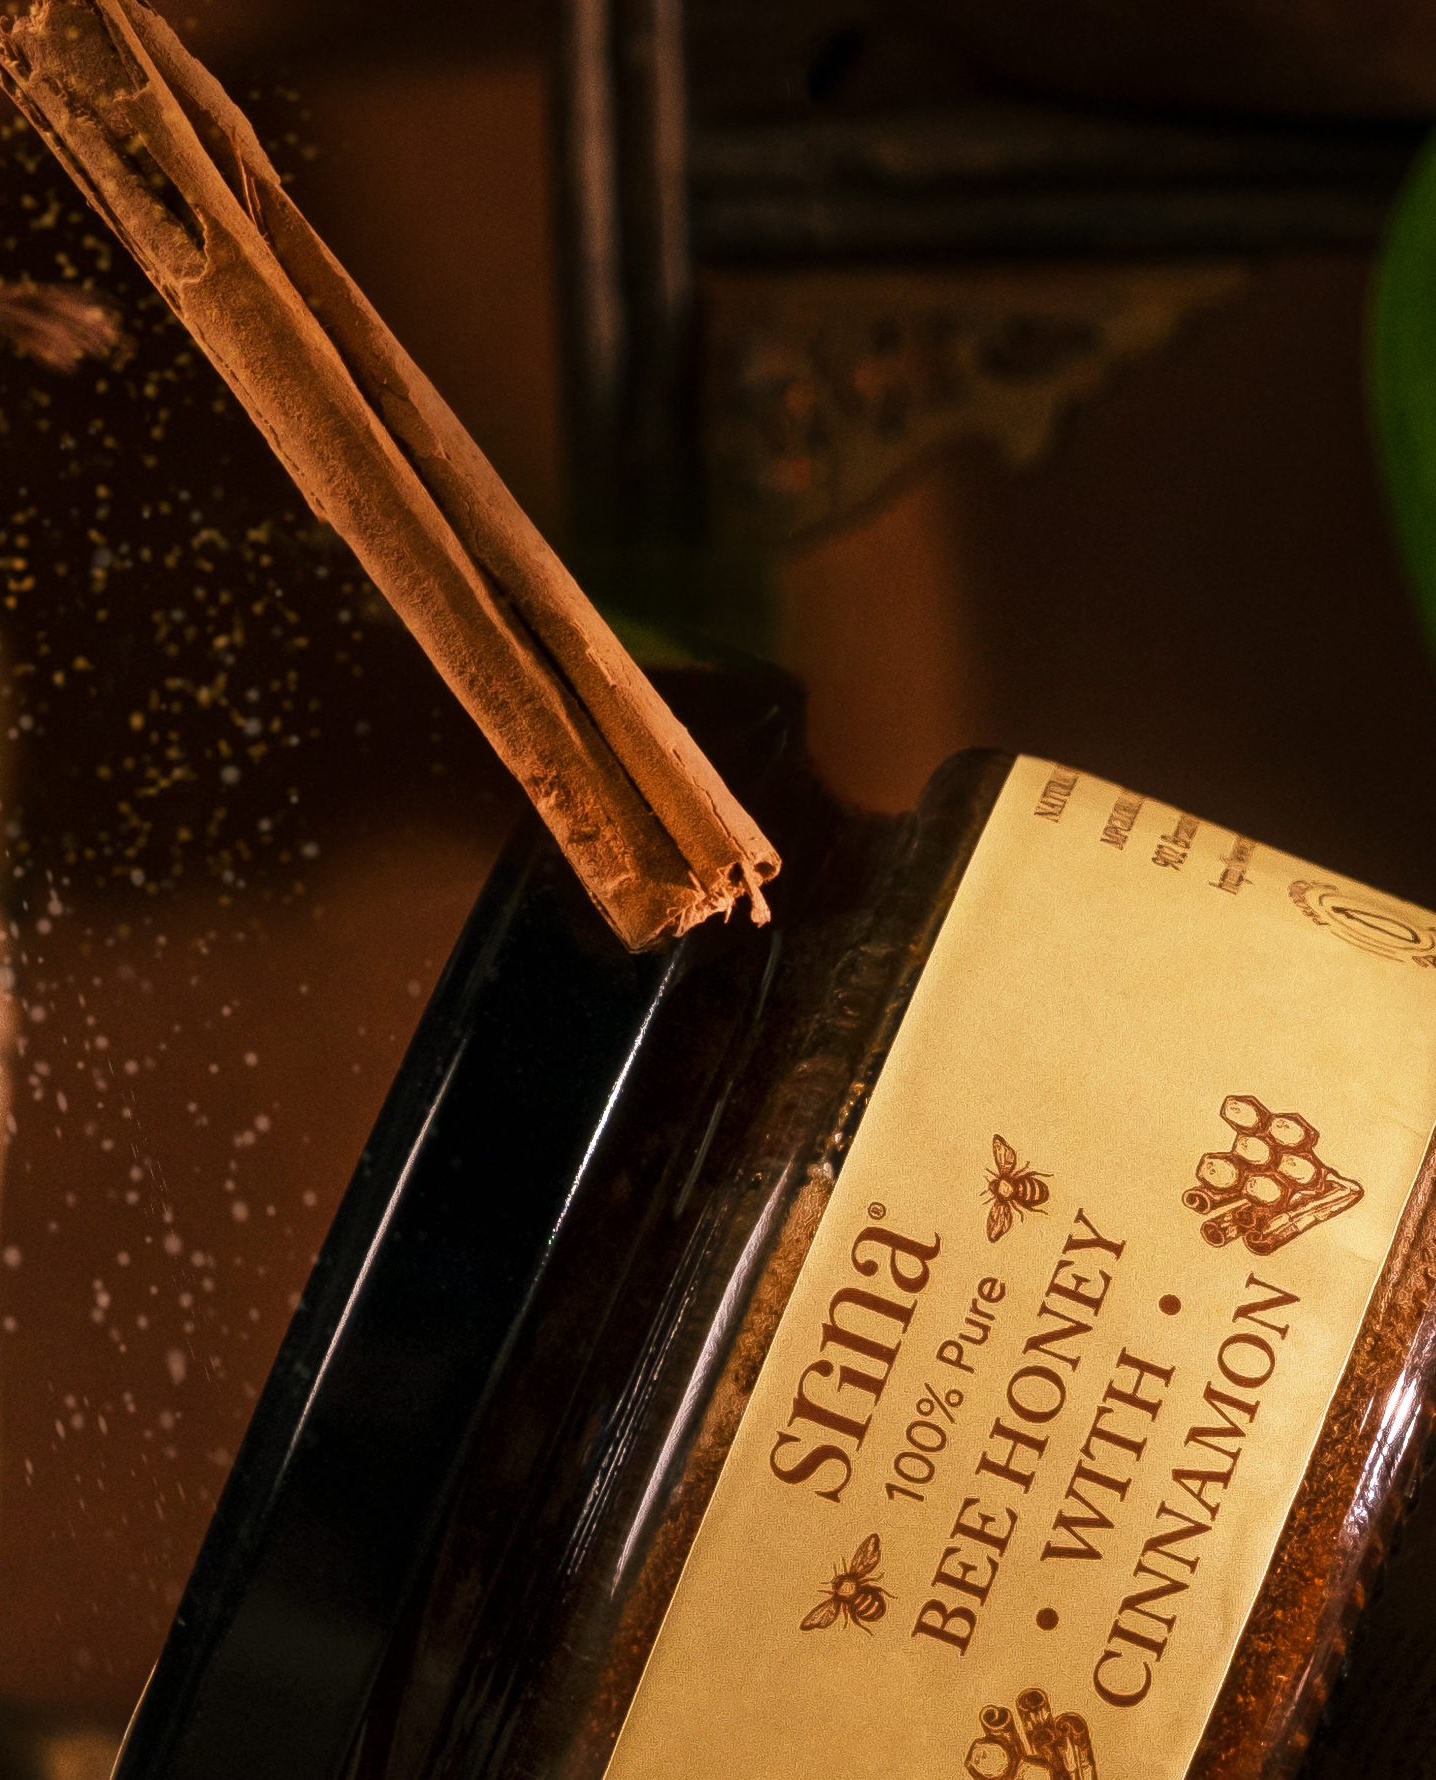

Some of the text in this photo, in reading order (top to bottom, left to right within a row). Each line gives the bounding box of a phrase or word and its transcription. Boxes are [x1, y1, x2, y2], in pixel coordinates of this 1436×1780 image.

[885, 1274, 1007, 1504] 100% Pure
[911, 1208, 1128, 1657] BEE HONEY
[1042, 1346, 1177, 1563] WITH
[1092, 1271, 1304, 1708] CINNAMON
